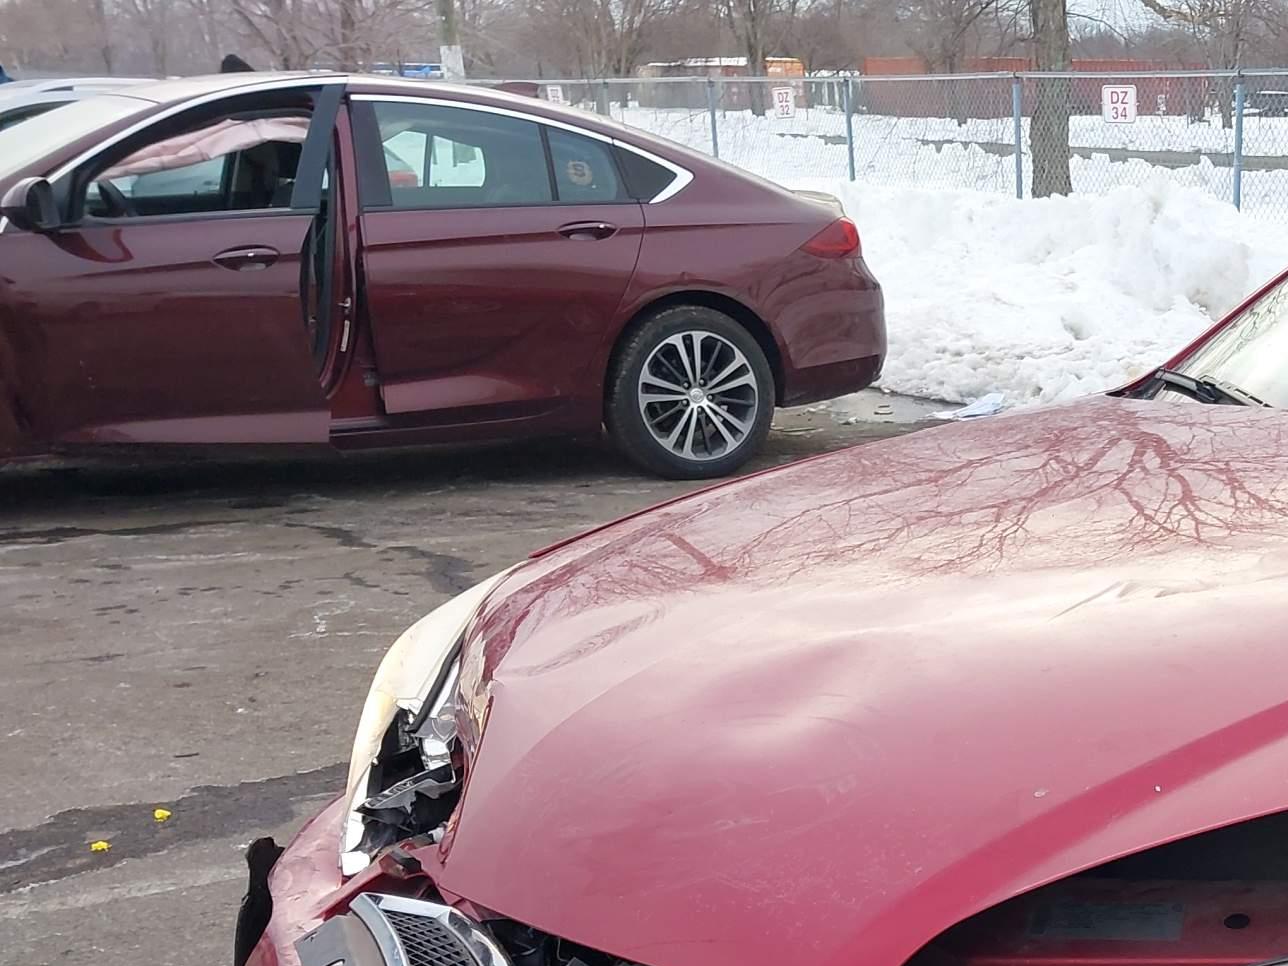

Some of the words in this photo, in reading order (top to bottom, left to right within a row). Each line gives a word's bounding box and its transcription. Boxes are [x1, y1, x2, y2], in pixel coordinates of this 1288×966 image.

[777, 91, 790, 103] DZ
[1110, 91, 1129, 105] DZ
[780, 104, 791, 116] 32
[1111, 106, 1128, 120] 34
